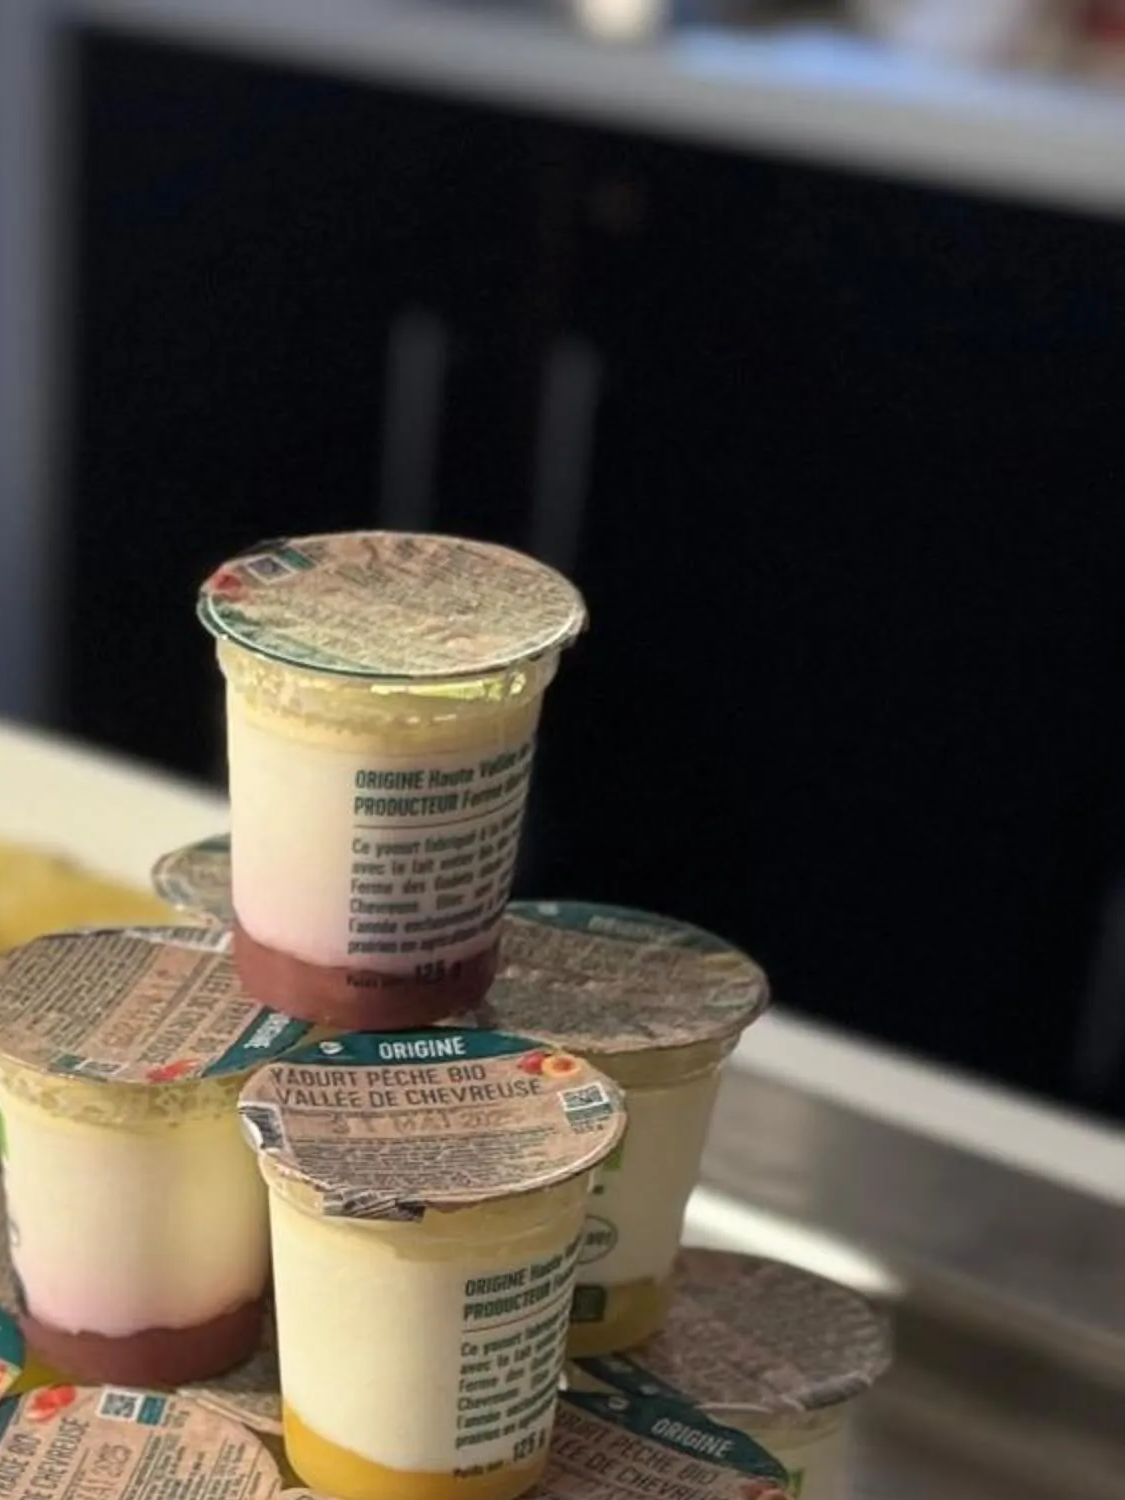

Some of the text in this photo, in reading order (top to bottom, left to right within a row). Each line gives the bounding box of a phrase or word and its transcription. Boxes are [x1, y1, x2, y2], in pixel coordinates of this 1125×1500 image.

[355, 769, 424, 790] ORIGINE
[354, 794, 458, 817] PRODUCTEUR
[378, 1036, 466, 1060] ORIGINE
[272, 1064, 487, 1089] YAOURT PÊCHE BIO
[275, 1078, 543, 1109] VALLÉE DE CHEVREUSE
[465, 1268, 525, 1297] ORIGINE
[463, 1282, 551, 1321] PRODUCTEUR
[651, 1417, 735, 1458] ORIGINE
